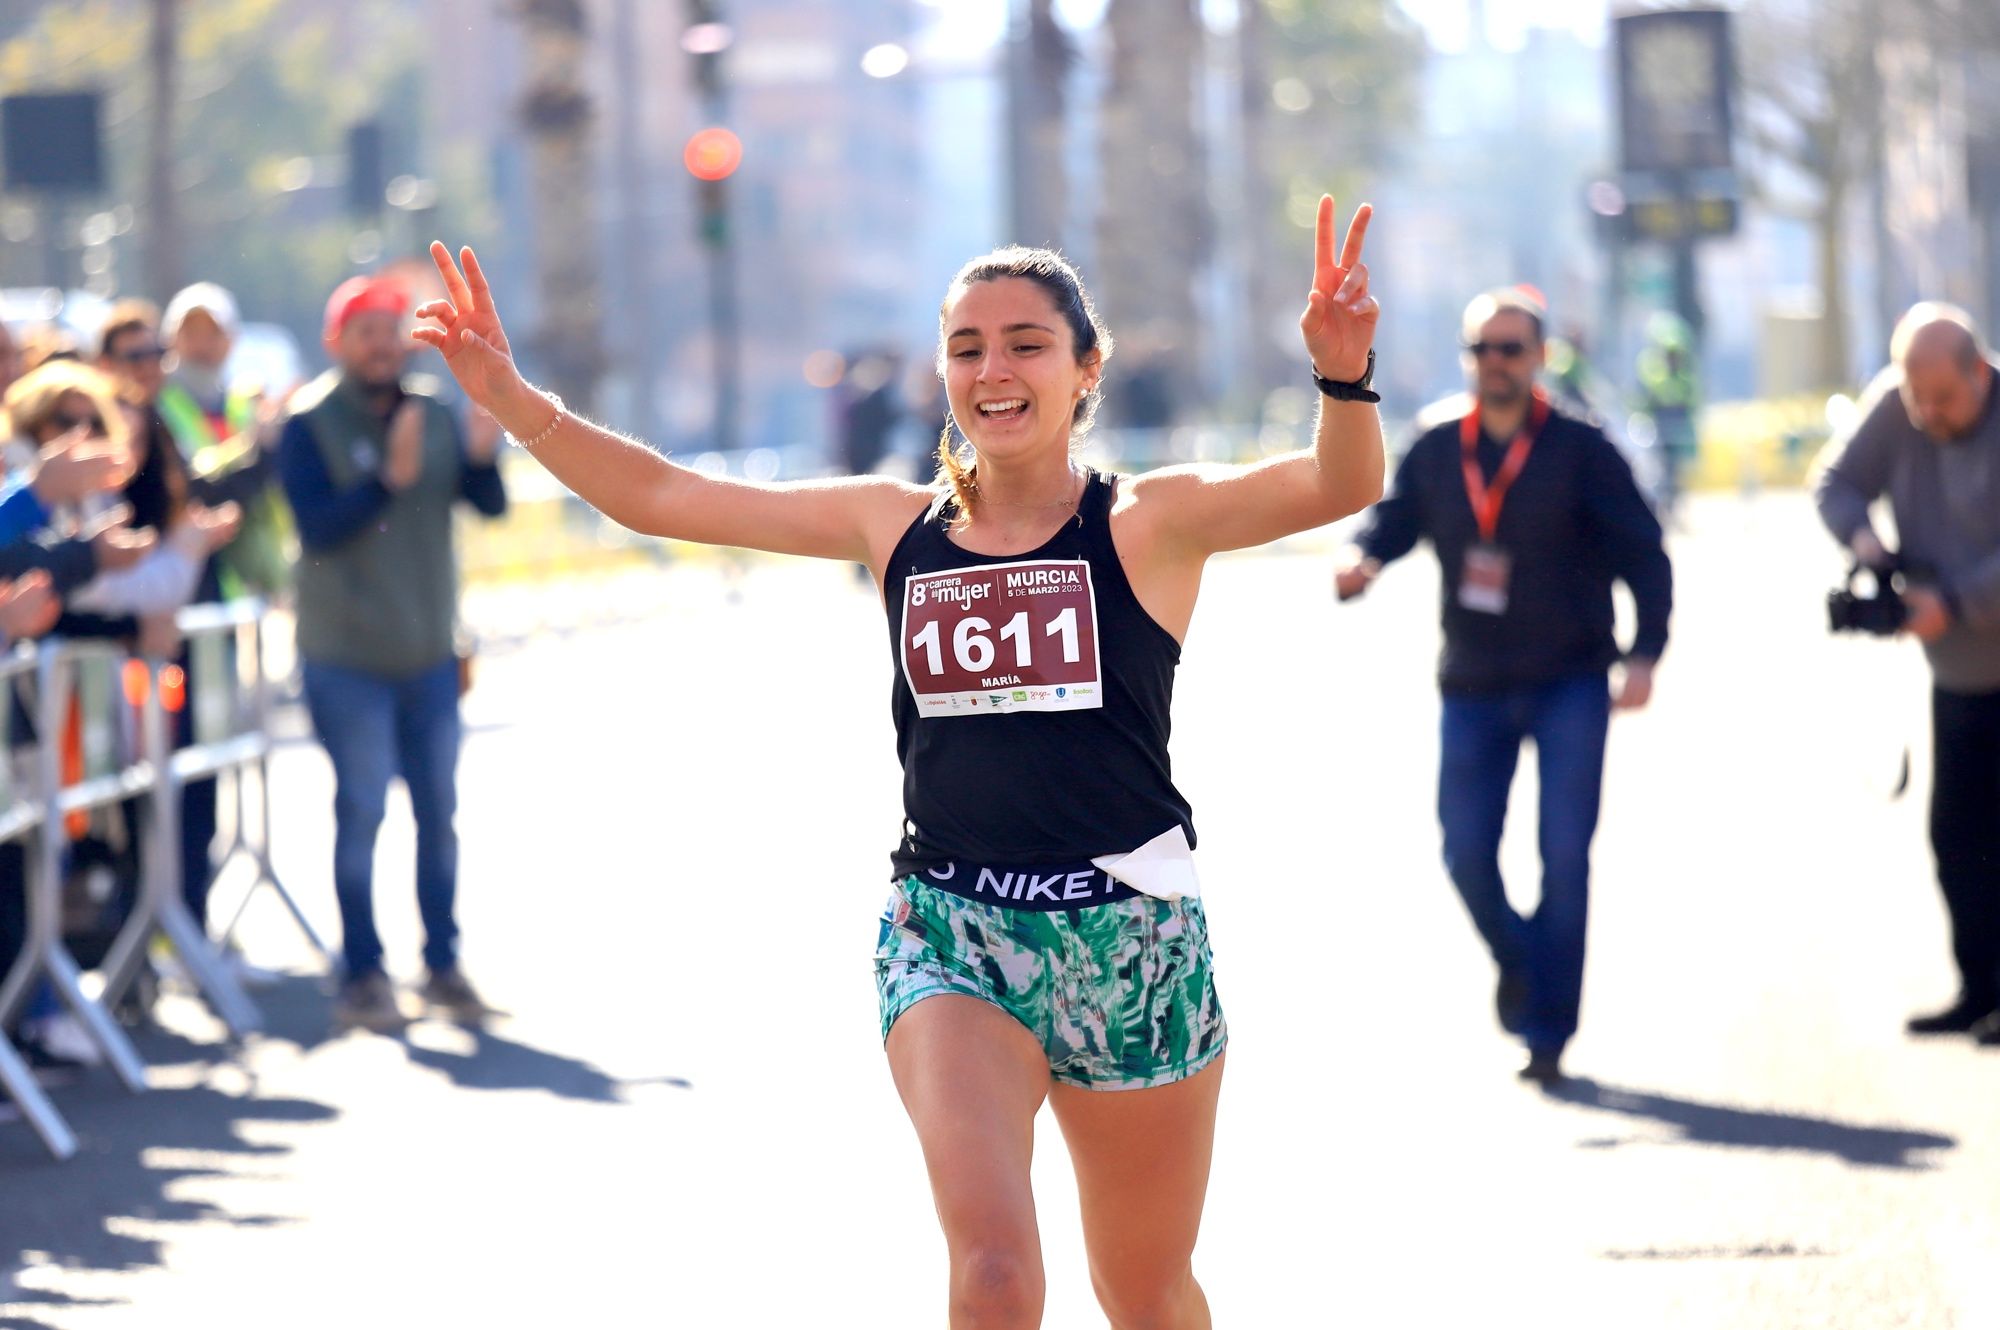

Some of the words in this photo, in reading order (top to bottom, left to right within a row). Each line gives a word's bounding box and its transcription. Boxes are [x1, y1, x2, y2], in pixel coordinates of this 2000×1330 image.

[929, 577, 961, 589] carrera
[1006, 570, 1079, 588] MURCIA
[937, 582, 992, 611] mujer
[1015, 588, 1027, 597] DE
[1028, 585, 1060, 595] MARZO
[1061, 584, 1083, 593] 2023
[912, 607, 1080, 676] 1611
[981, 674, 1021, 688] MARÍA
[974, 867, 1096, 901] NIKE
